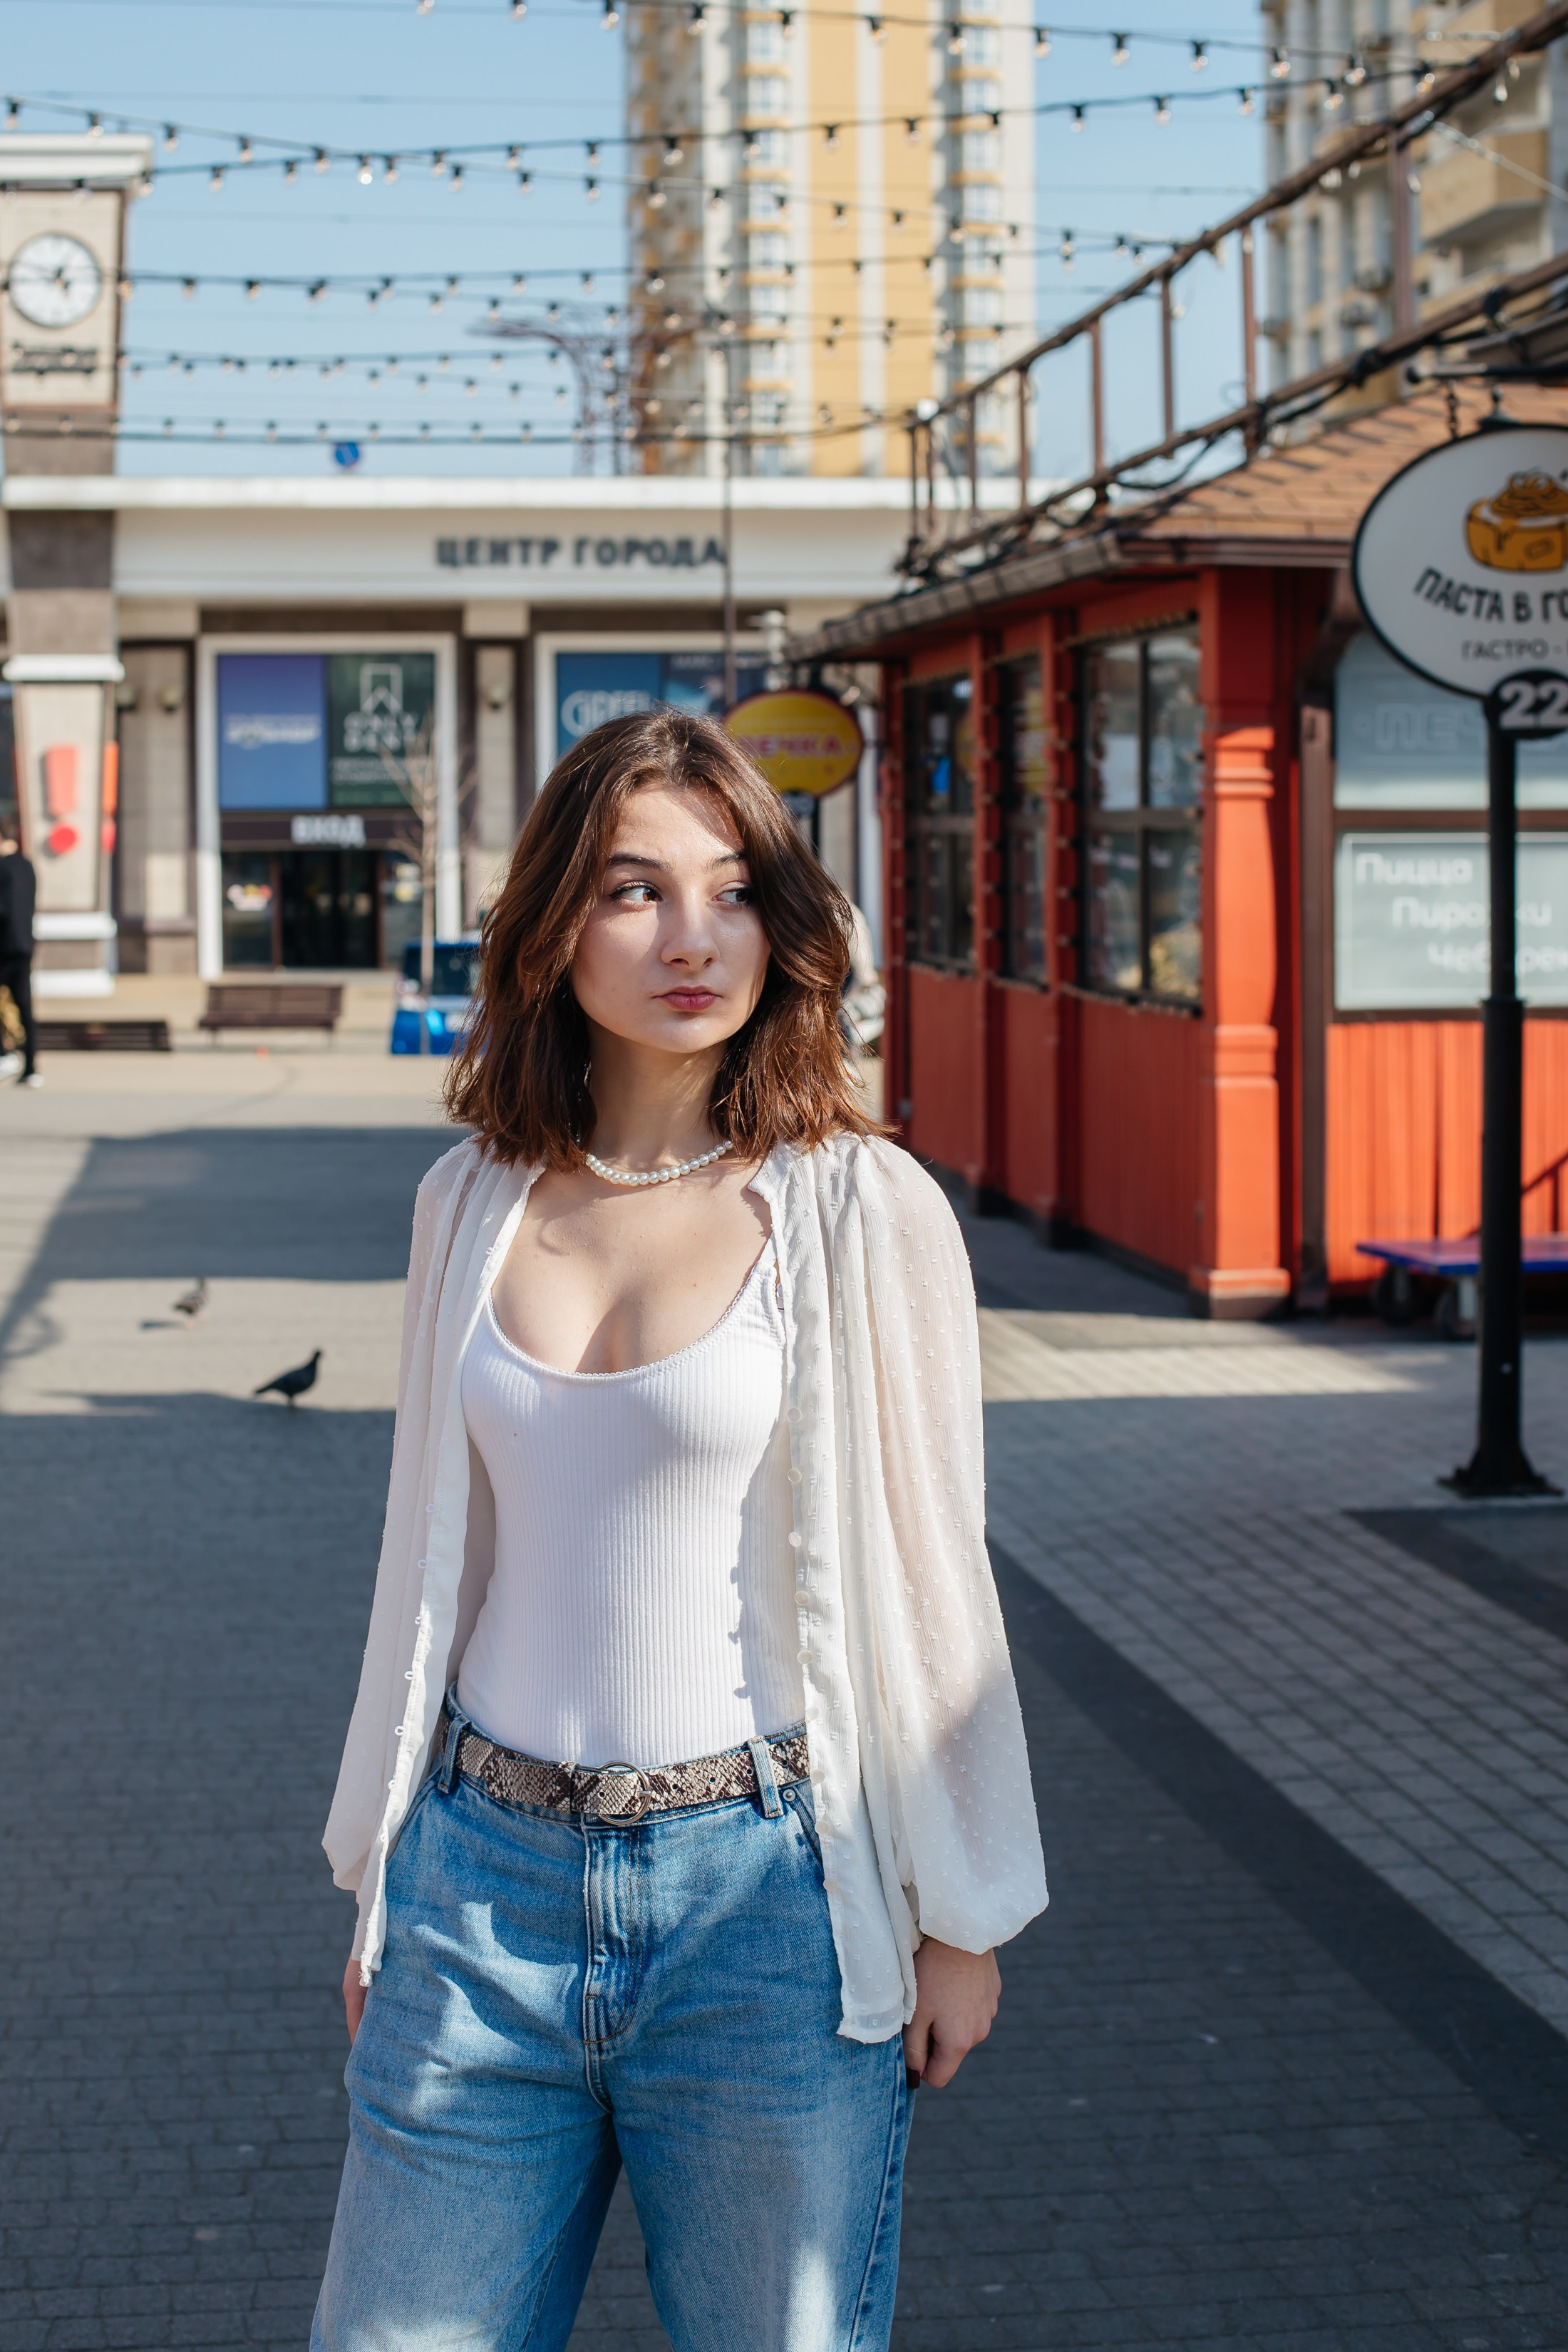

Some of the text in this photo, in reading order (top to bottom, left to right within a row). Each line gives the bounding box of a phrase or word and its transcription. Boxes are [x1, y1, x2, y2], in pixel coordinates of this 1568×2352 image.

[436, 537, 728, 569] ЦЕНТР ГОРОДА
[1413, 567, 1505, 623] ПАСТА
[1513, 591, 1532, 623] В
[1462, 638, 1549, 661] ГАСТРО
[291, 815, 367, 849] ВХОД
[1356, 852, 1473, 887] Пицца
[1392, 896, 1553, 934] Пироки
